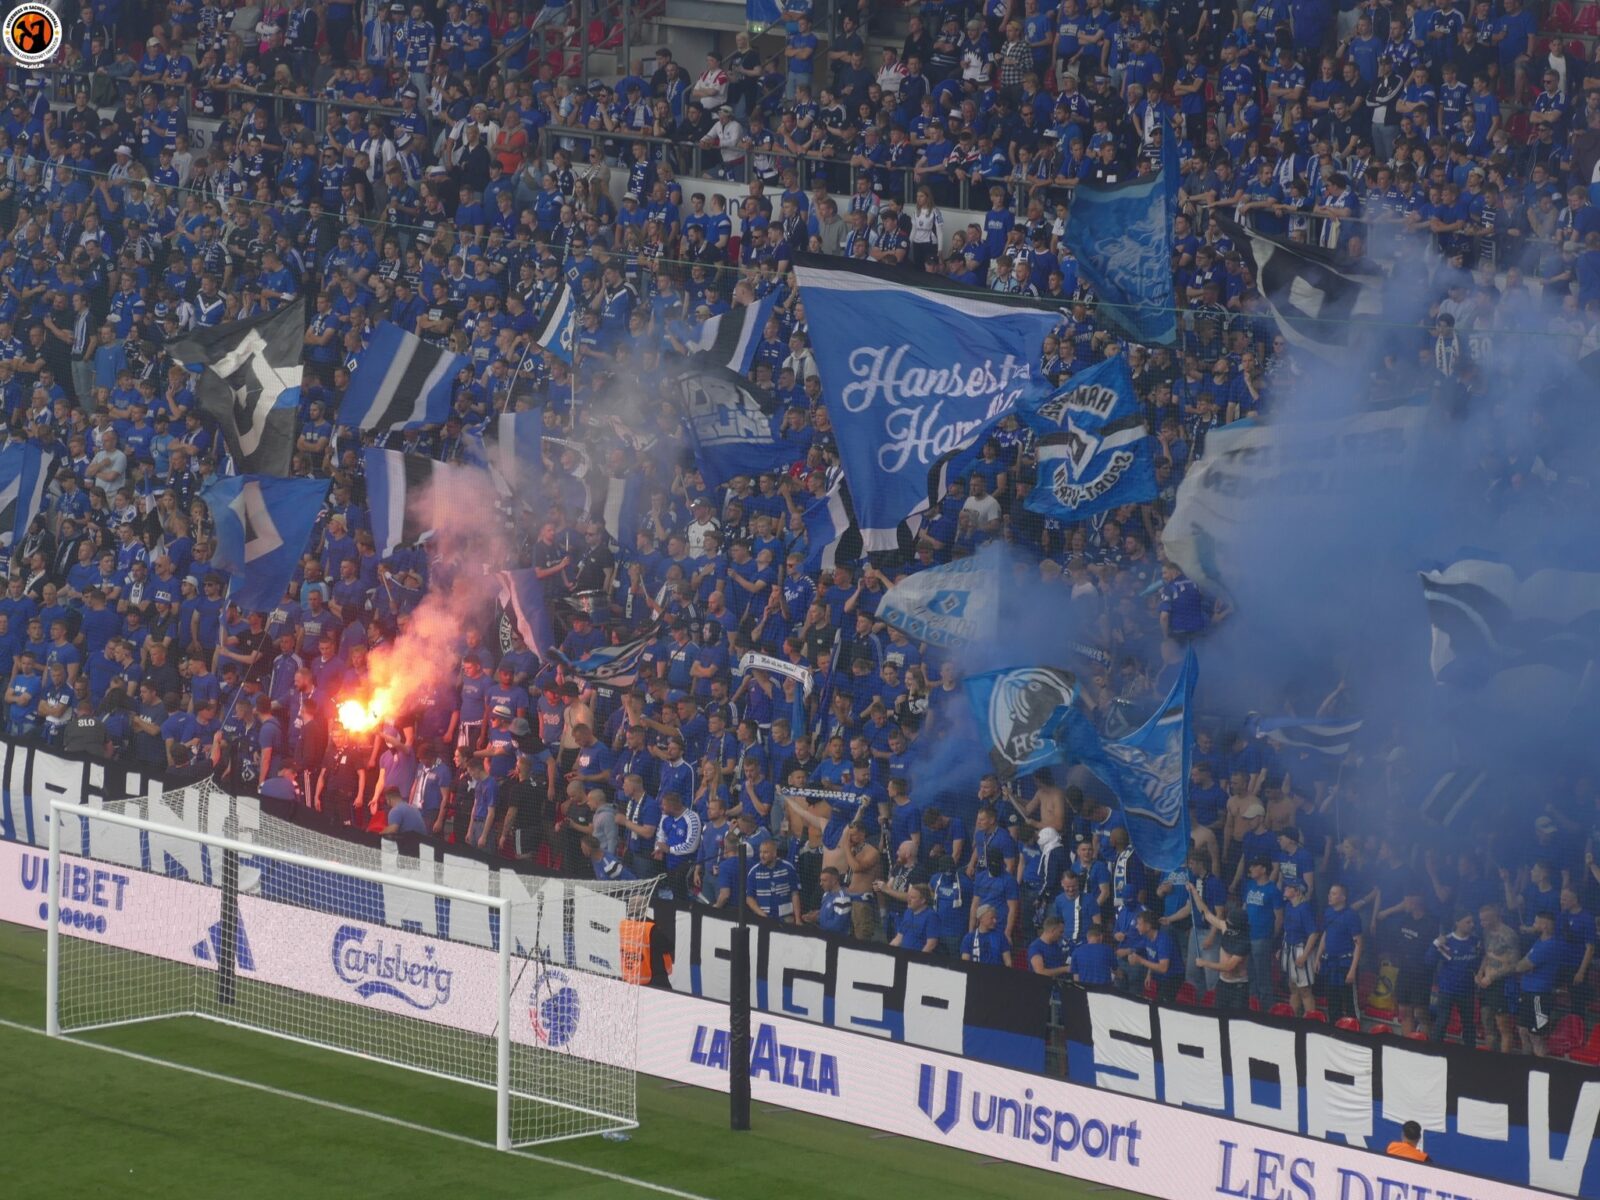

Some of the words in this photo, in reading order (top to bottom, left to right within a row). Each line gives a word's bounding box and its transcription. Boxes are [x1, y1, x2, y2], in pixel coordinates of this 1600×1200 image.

[332, 924, 453, 1007] Carlsberg
[690, 1023, 841, 1097] LAAZZA
[972, 1088, 1141, 1166] unisport
[1215, 1139, 1317, 1200] LES
